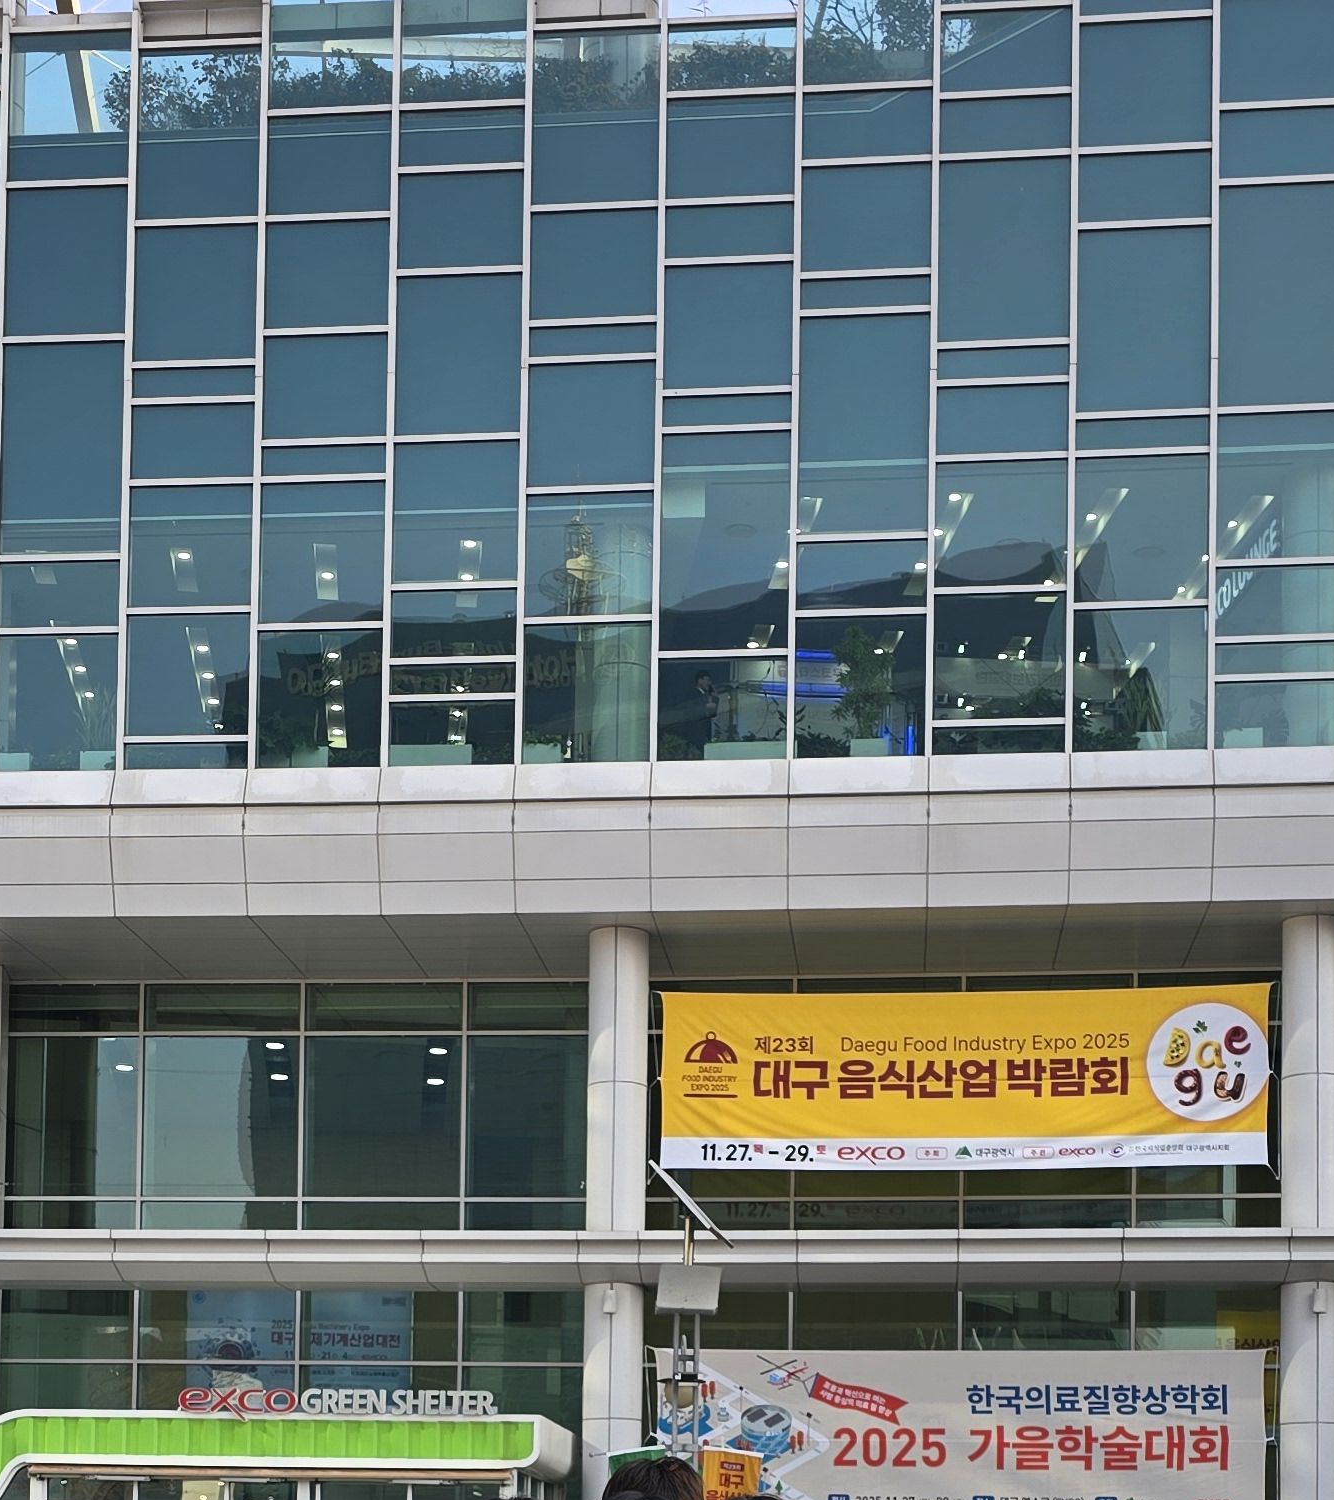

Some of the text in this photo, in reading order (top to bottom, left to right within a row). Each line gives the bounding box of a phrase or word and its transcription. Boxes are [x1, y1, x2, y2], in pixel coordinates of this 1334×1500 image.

[755, 1036, 813, 1054] 제23회
[841, 1033, 1130, 1055] Daegu Food Industry Expo 2025
[682, 1075, 737, 1083] FOOD INDUSTRY
[698, 1066, 722, 1074] DAEGU
[753, 1057, 1130, 1100] 대구 음식산업 박람회
[299, 1387, 387, 1415] GREEN
[391, 1387, 497, 1416] SHELTER
[967, 1384, 1228, 1415] 한국의료질향상학회
[834, 1425, 1230, 1472] 2025 가을학술대회
[719, 1473, 744, 1489] 대구
